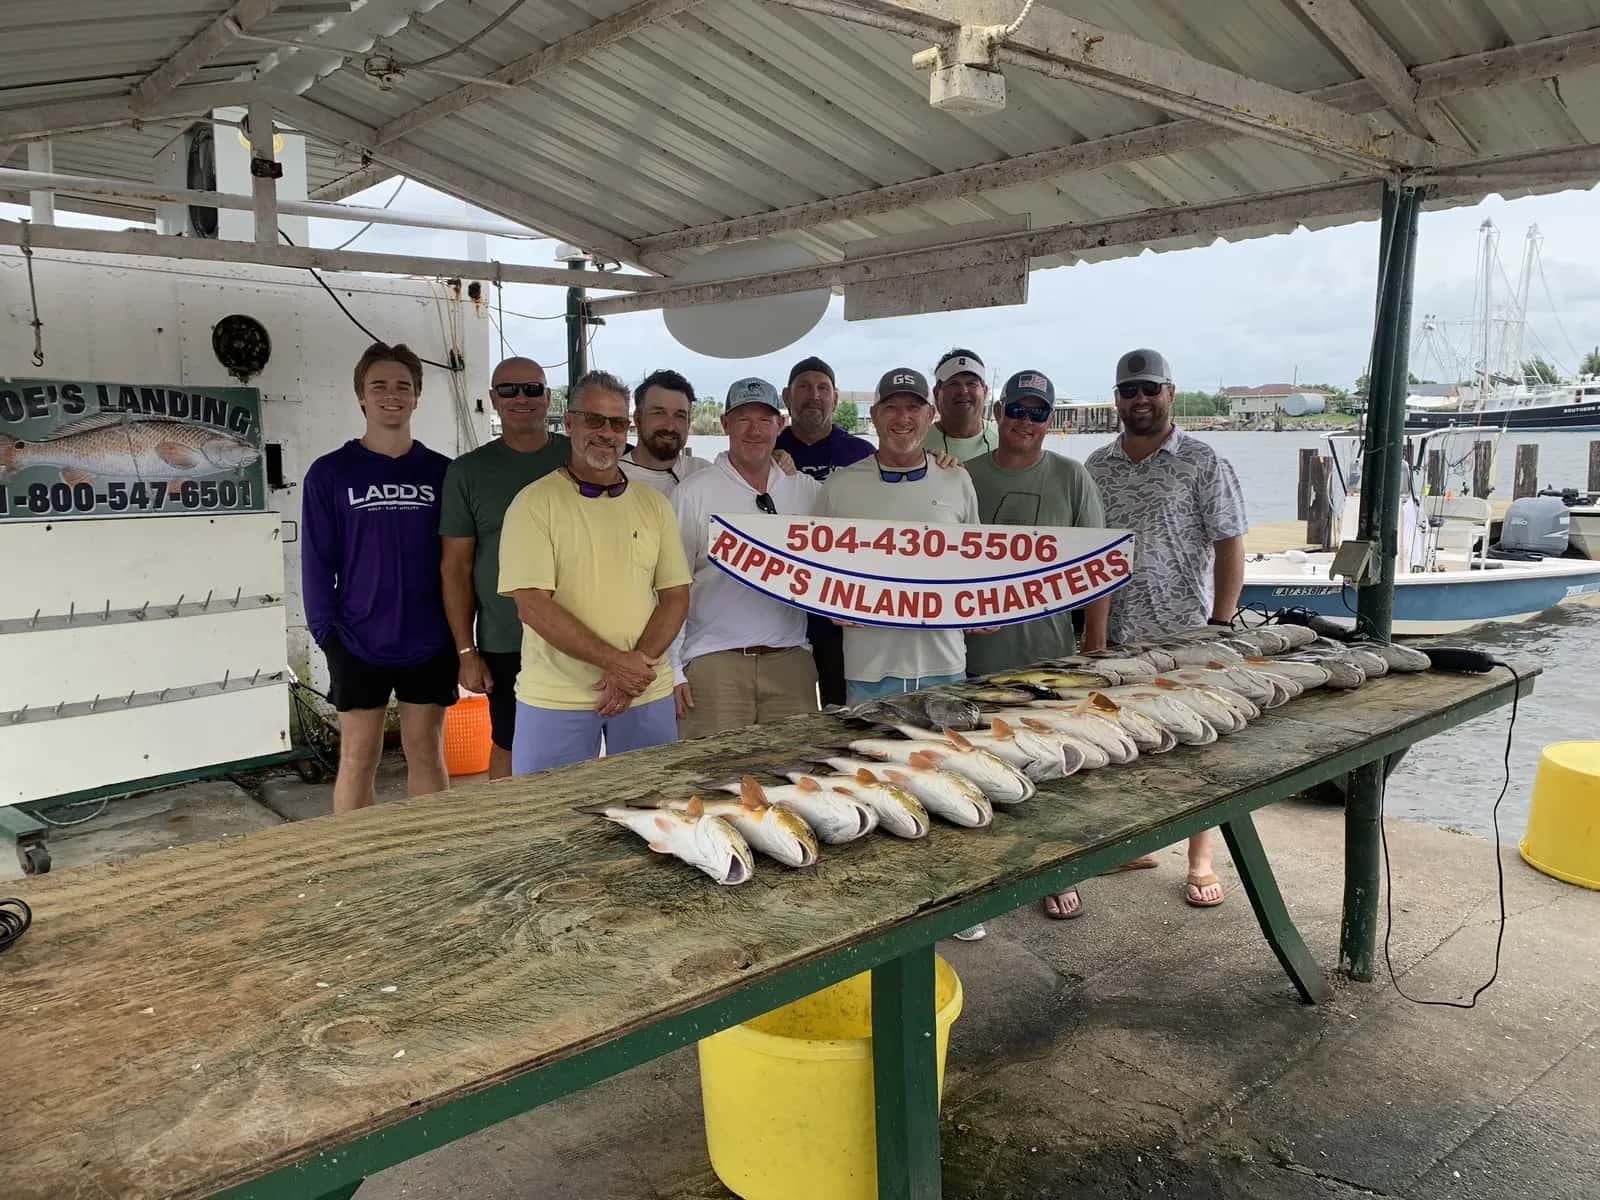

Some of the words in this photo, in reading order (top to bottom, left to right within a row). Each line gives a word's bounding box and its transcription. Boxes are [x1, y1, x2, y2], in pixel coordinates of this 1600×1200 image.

[893, 374, 915, 385] GS
[96, 384, 252, 435] LANDING
[0, 479, 252, 514] 1-800-547-6501
[786, 523, 1058, 562] 504-430-5506
[711, 530, 813, 596] RIPP'S
[818, 576, 943, 619] INLAND
[954, 549, 1130, 619] CHARTERS
